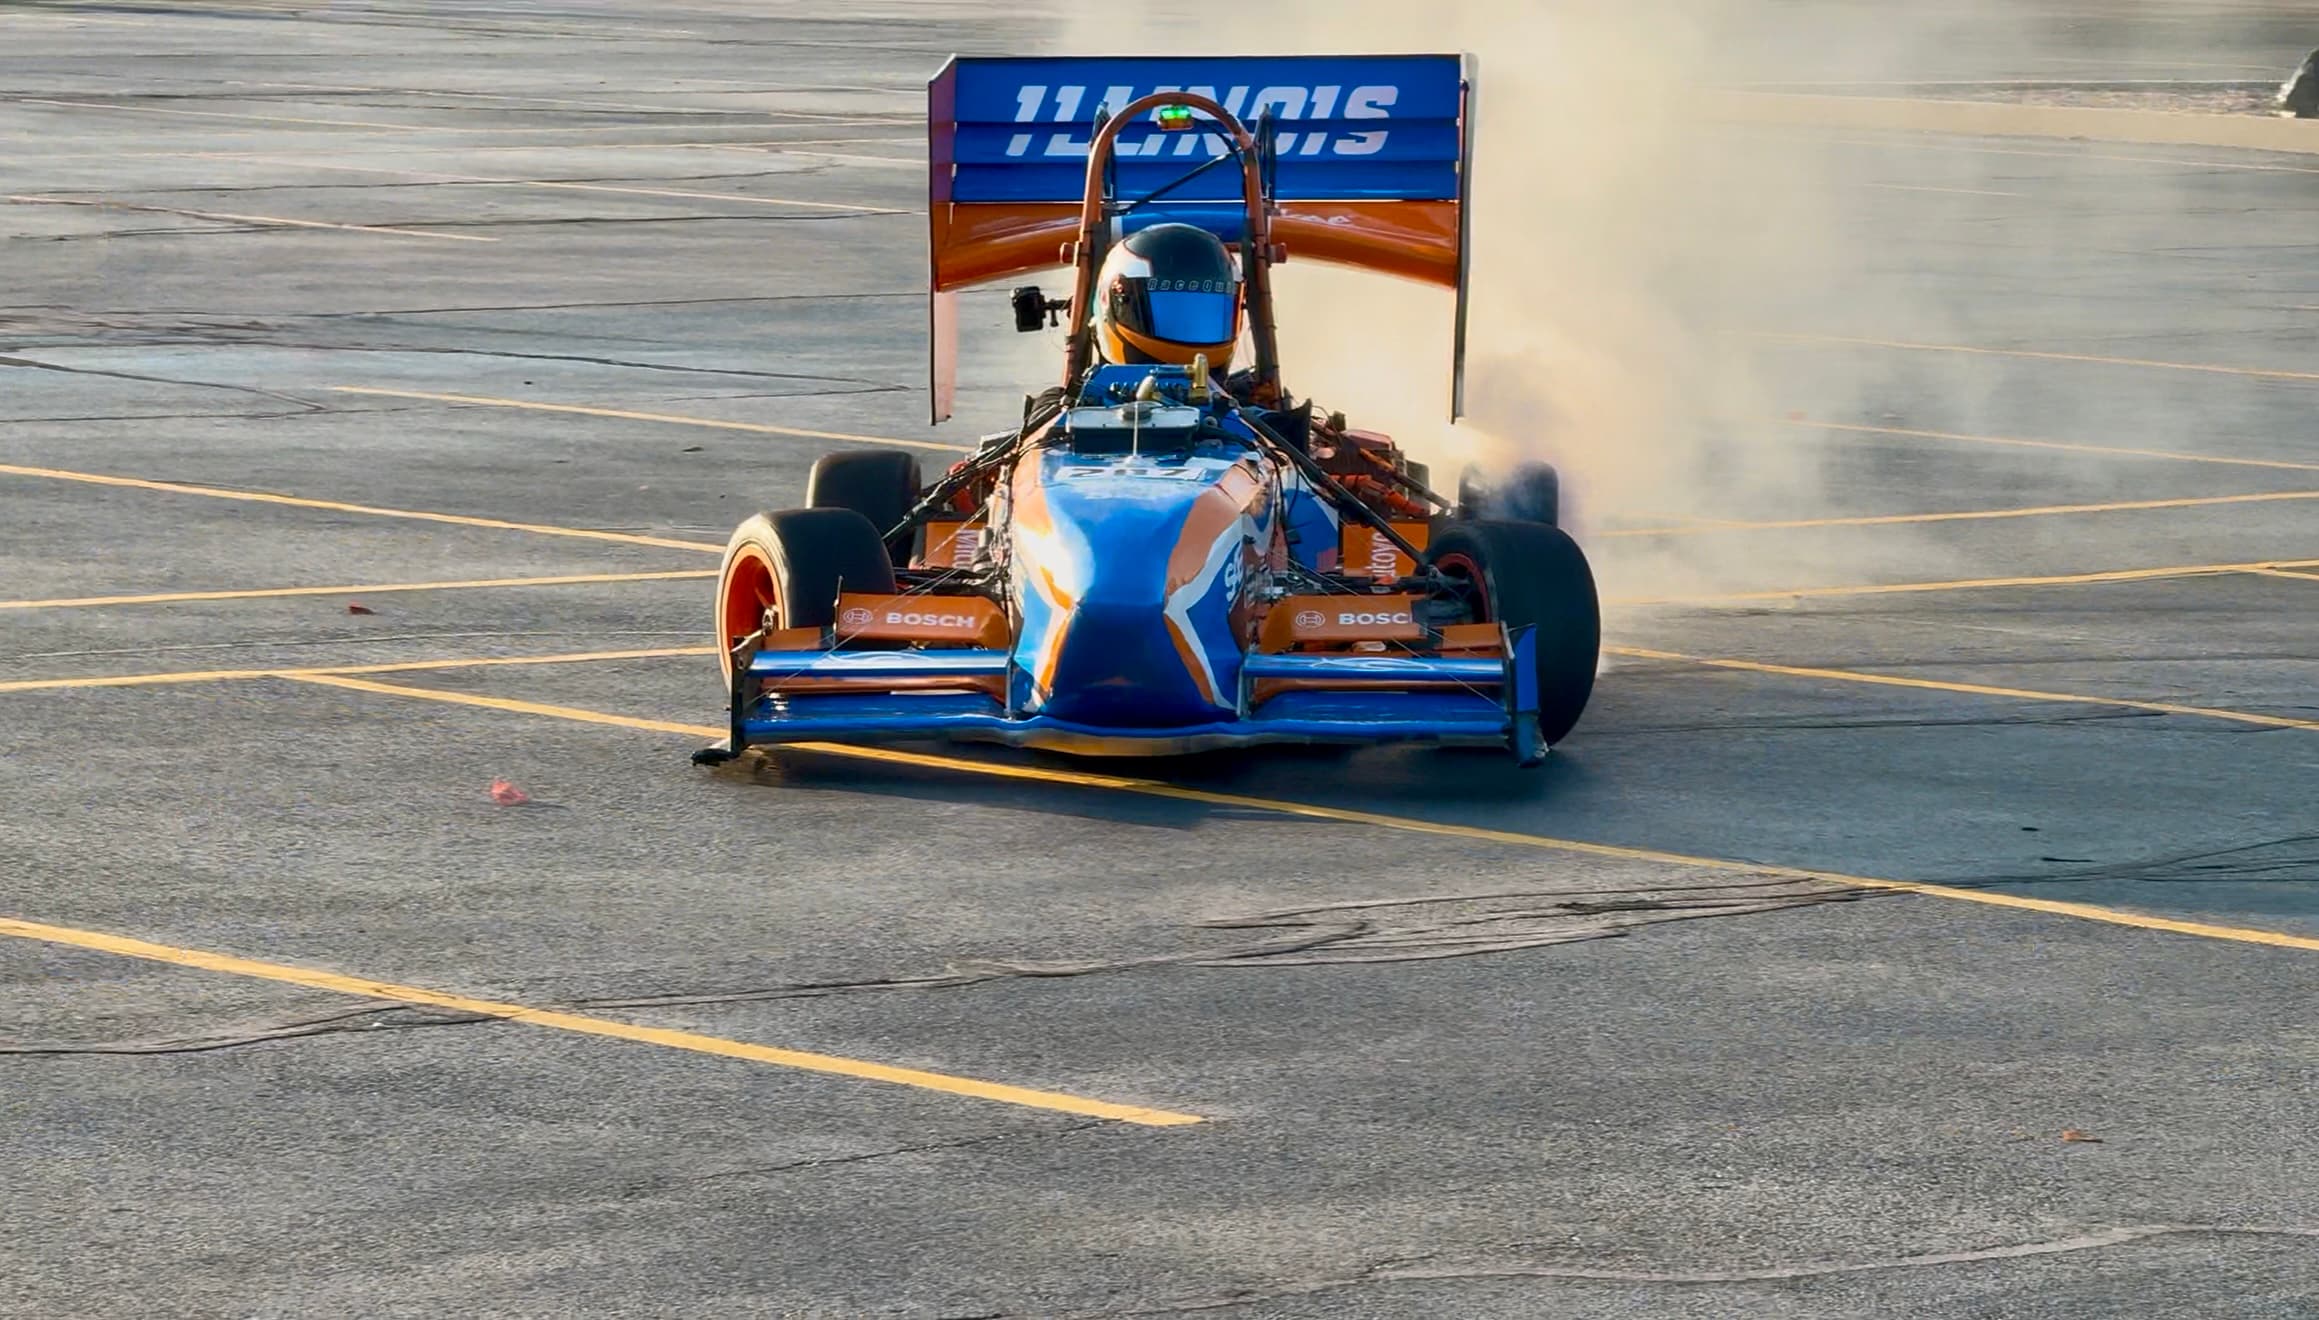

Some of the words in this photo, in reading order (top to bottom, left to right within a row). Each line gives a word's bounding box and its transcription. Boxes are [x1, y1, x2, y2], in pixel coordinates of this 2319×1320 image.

[1005, 85, 1398, 156] ILLINOIS
[886, 612, 975, 628] BOSCH
[1338, 612, 1413, 625] BOSC
